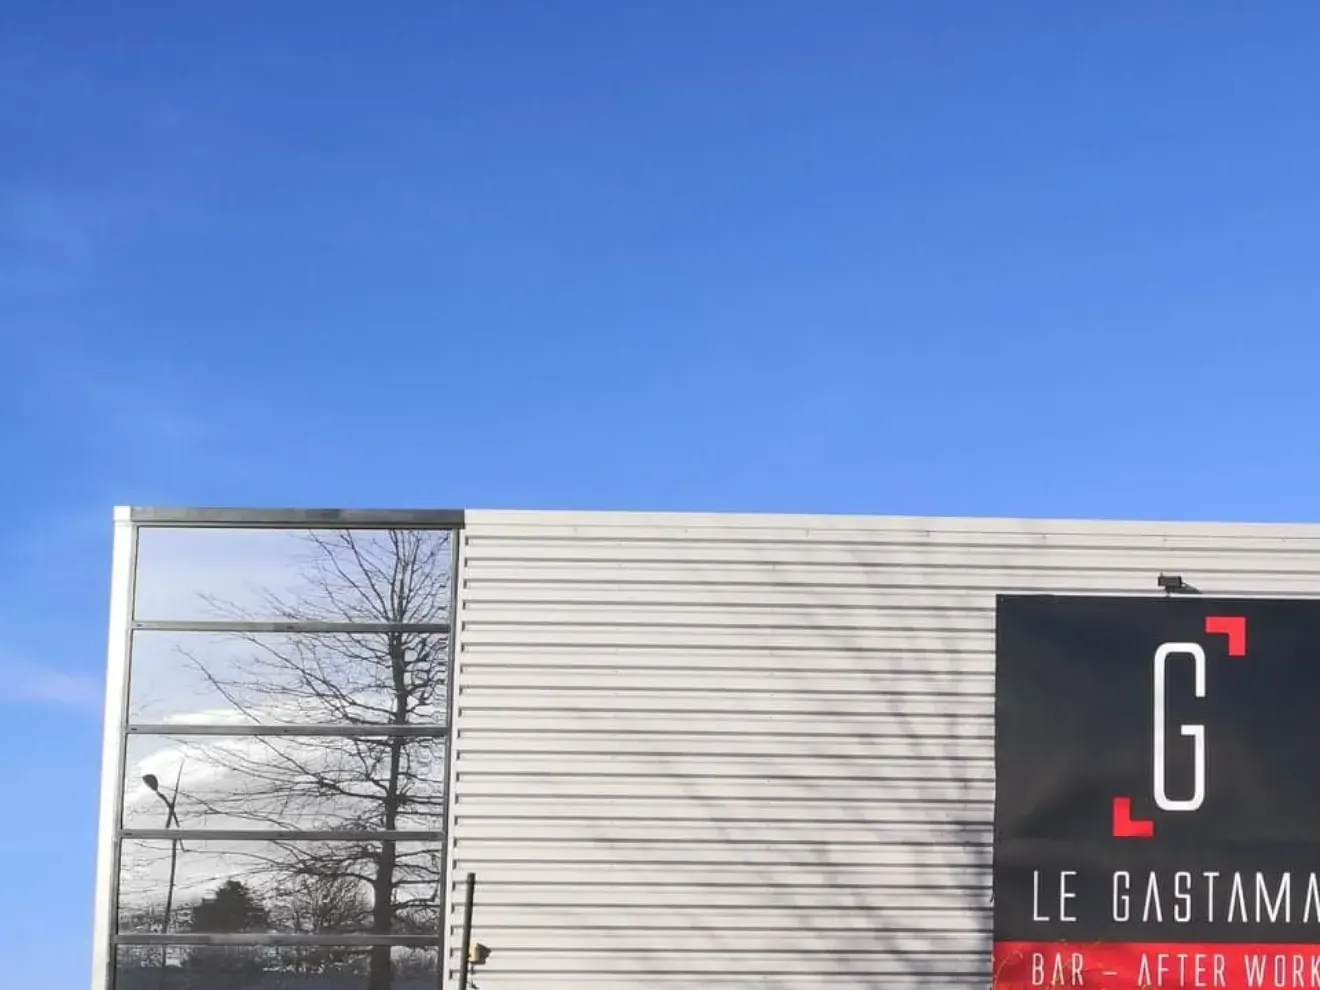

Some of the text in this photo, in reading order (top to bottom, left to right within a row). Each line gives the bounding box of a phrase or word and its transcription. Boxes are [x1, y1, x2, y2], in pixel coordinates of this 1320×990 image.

[1153, 642, 1206, 812] G
[1032, 870, 1077, 922] LE
[1031, 952, 1084, 987] BAR
[1137, 953, 1226, 988] AFTER
